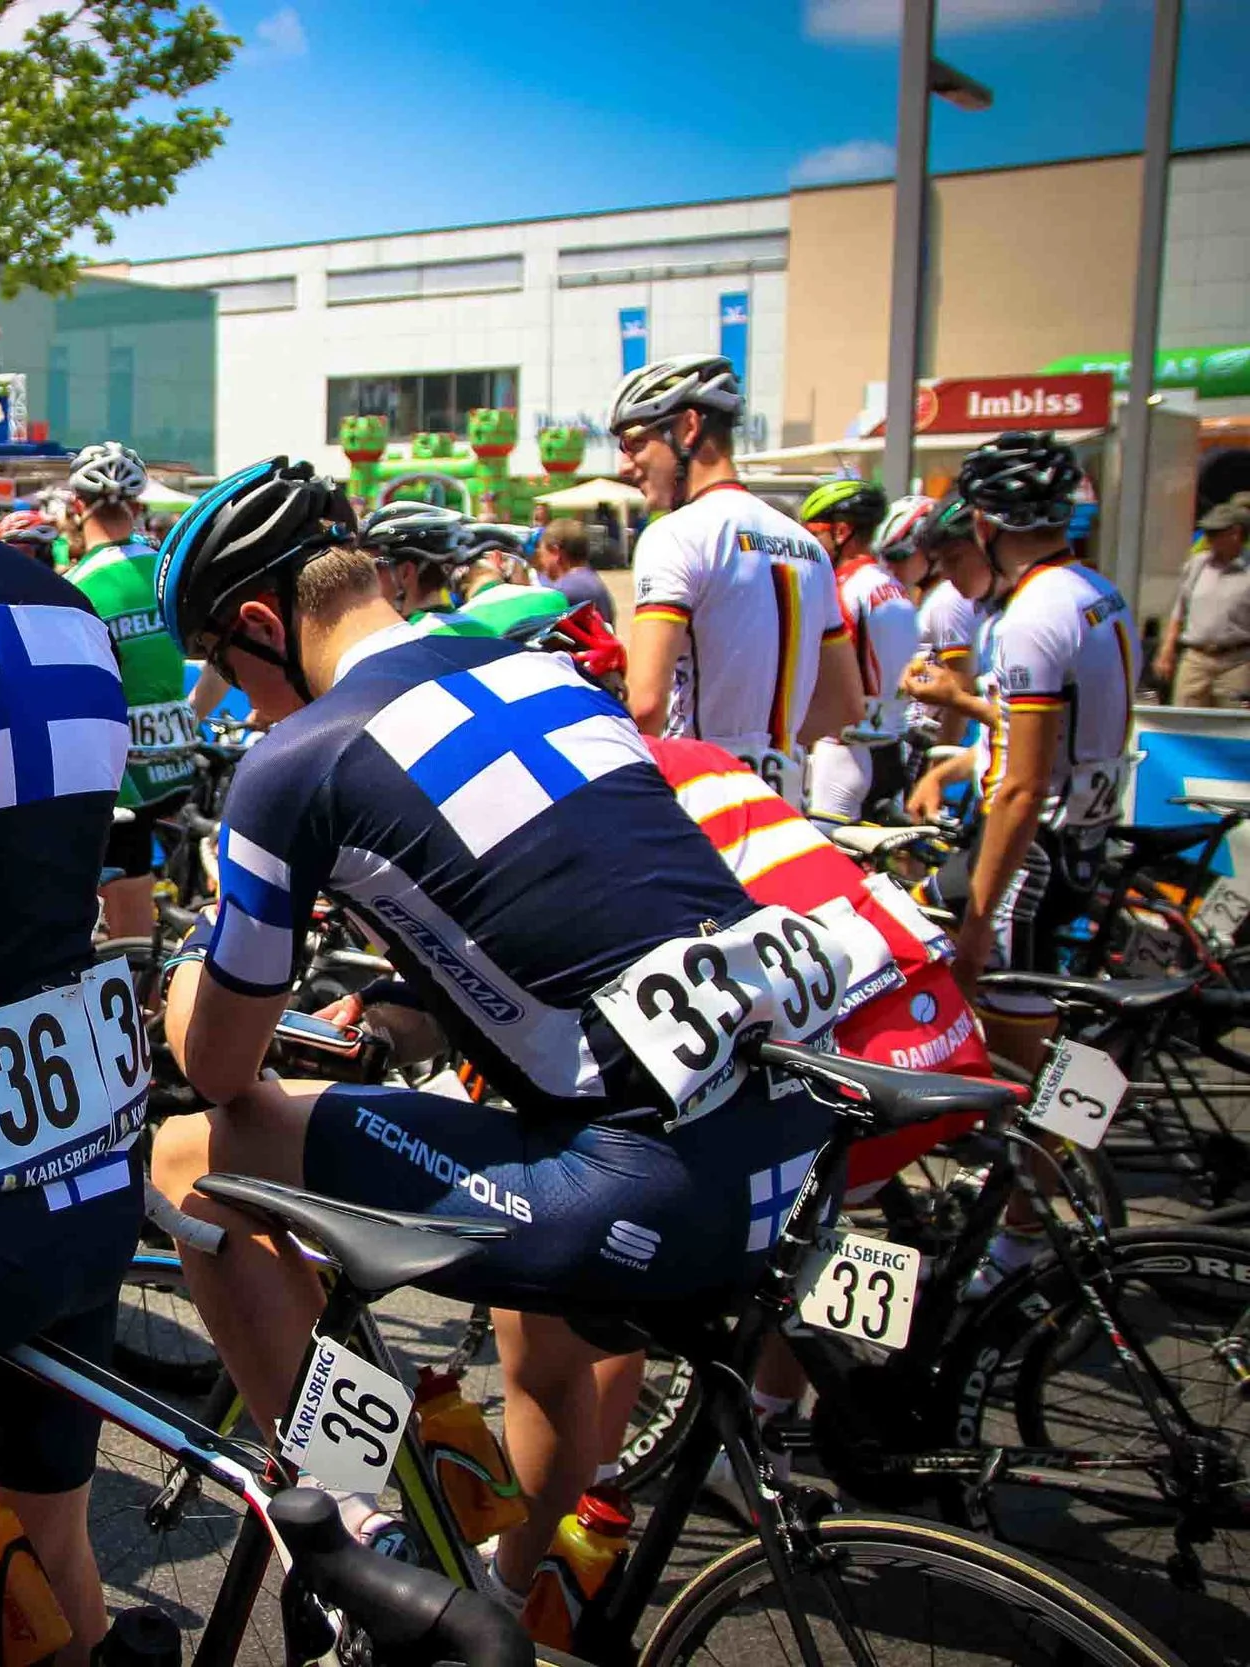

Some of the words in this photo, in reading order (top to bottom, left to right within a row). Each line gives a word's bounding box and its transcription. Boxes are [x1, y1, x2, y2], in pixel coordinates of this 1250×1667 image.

[966, 388, 1083, 419] Imbiss
[1083, 767, 1119, 818] 24
[380, 903, 513, 1018] HELKAMA
[636, 942, 753, 1072] 33
[753, 917, 837, 1029] 33
[890, 1011, 974, 1069] DANMARK
[1032, 1050, 1073, 1120] KARLSBERG
[1058, 1086, 1108, 1121] 3
[24, 1134, 106, 1187] KARLSBERG
[353, 1105, 534, 1224] TECHNOPOLIS
[793, 1167, 817, 1220] RITCHEY
[826, 1260, 895, 1340] 33
[1195, 1255, 1250, 1284] RE
[290, 1348, 336, 1450] KARLSBERG
[321, 1378, 400, 1467] 36
[617, 1355, 694, 1473] REYNOL
[956, 1347, 1000, 1447] OLDS
